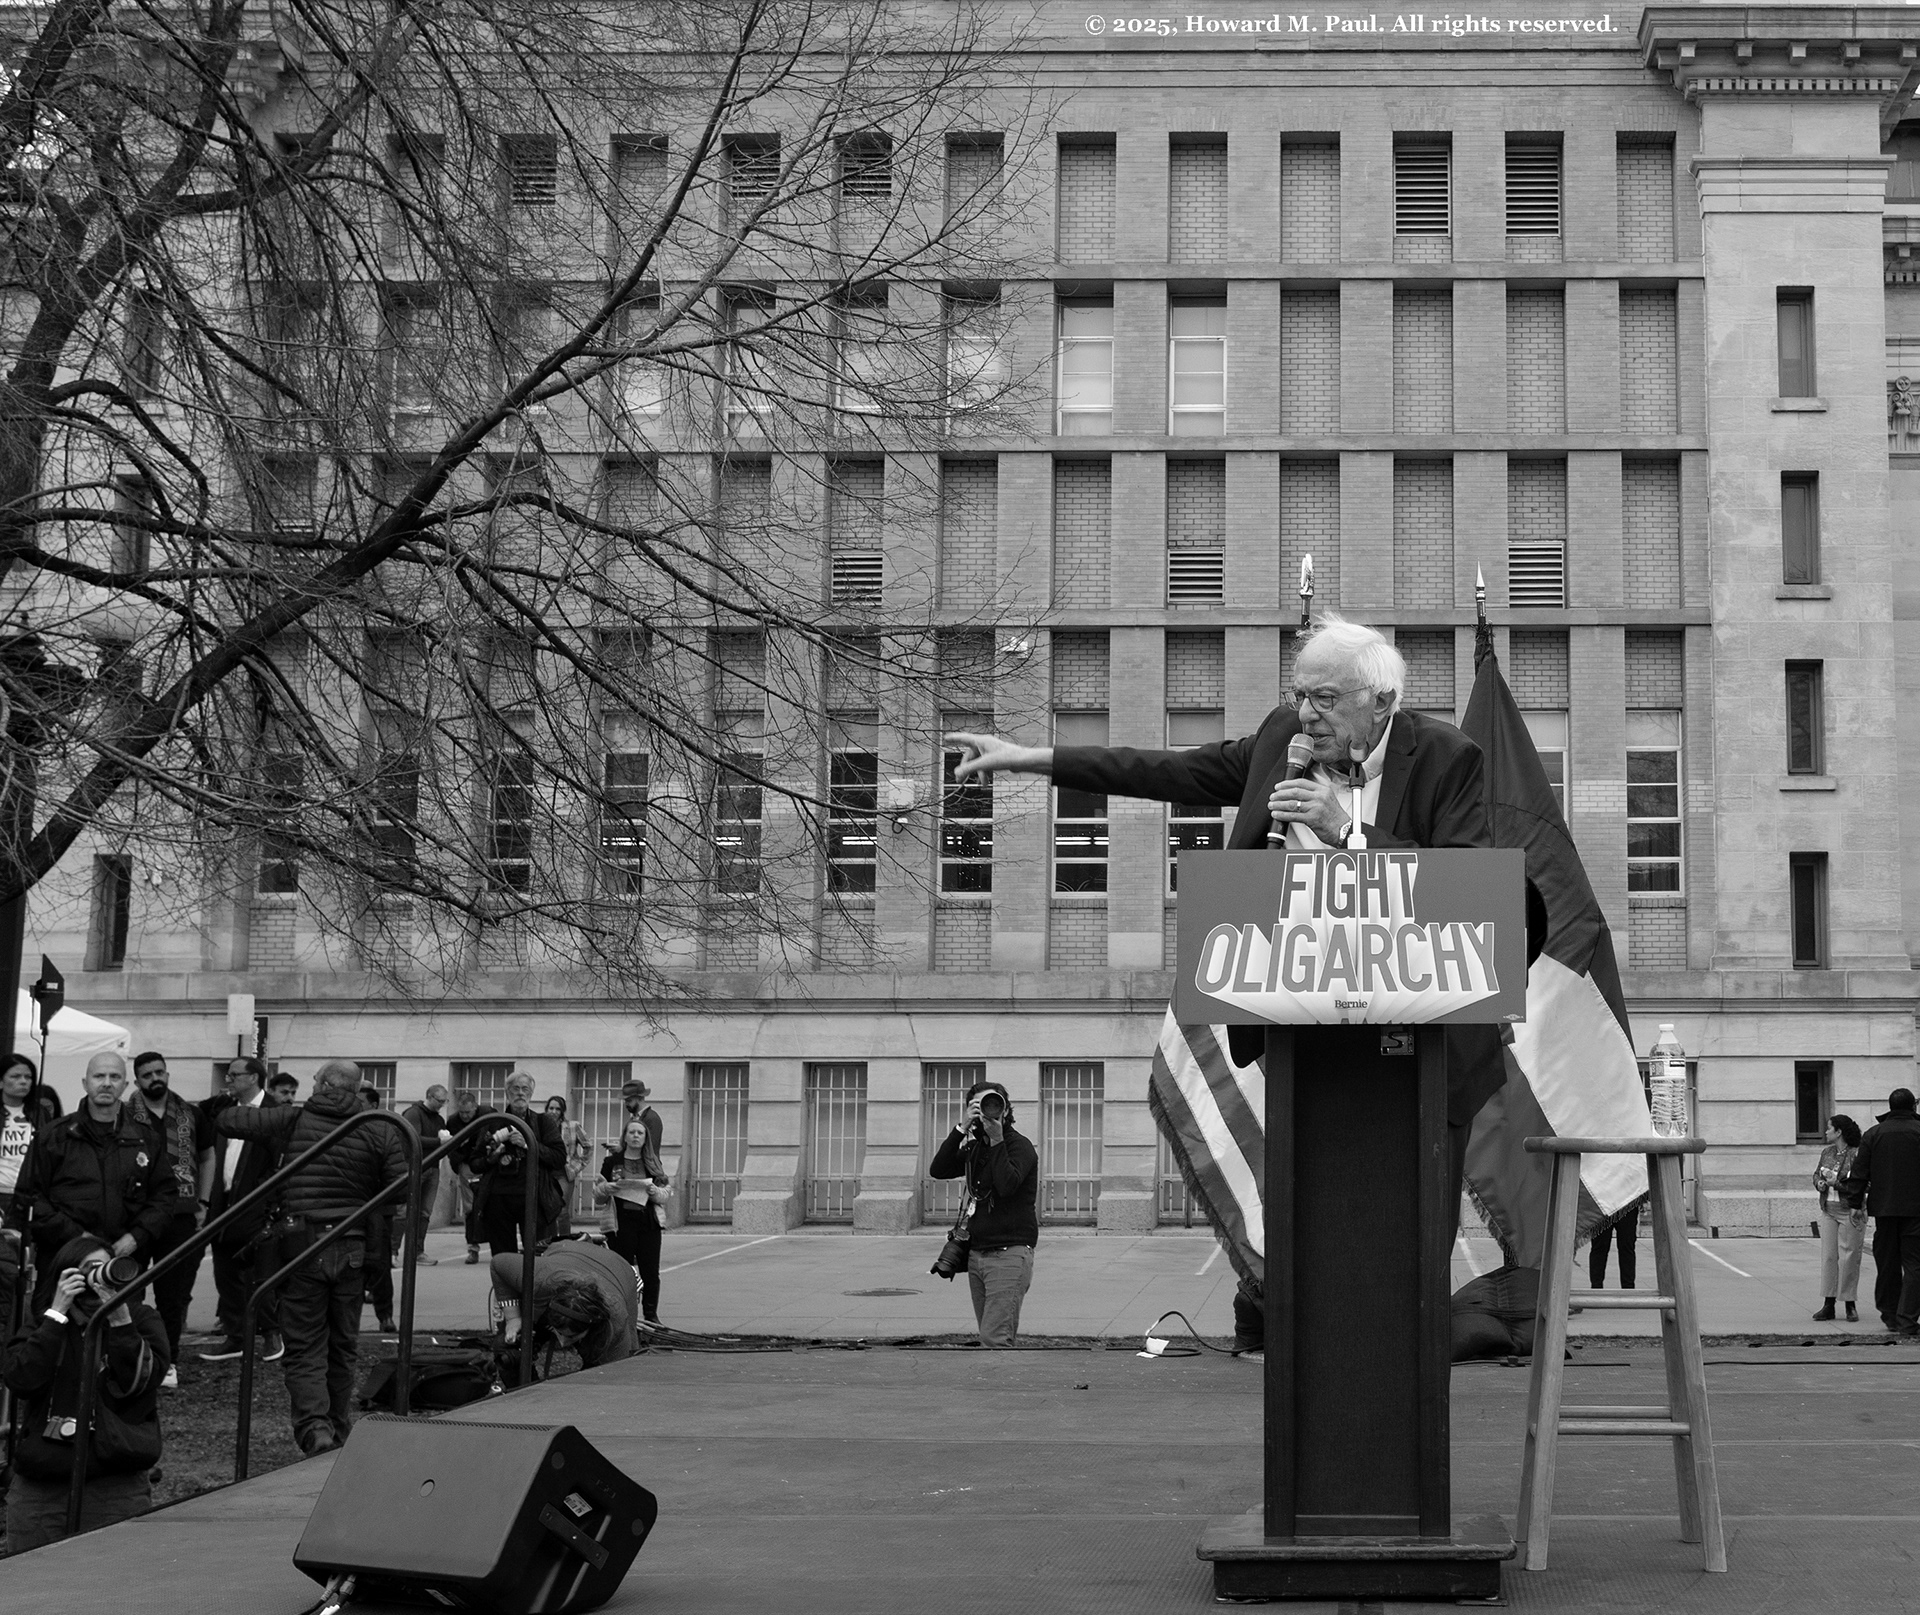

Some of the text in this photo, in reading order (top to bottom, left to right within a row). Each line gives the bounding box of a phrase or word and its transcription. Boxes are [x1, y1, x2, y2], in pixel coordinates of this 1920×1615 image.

[1279, 853, 1418, 919] FIGHT
[1195, 922, 1500, 993] OLIGARCHY
[1334, 999, 1368, 1009] Bernie
[5, 1130, 26, 1141] MY
[2, 1143, 29, 1157] NIO
